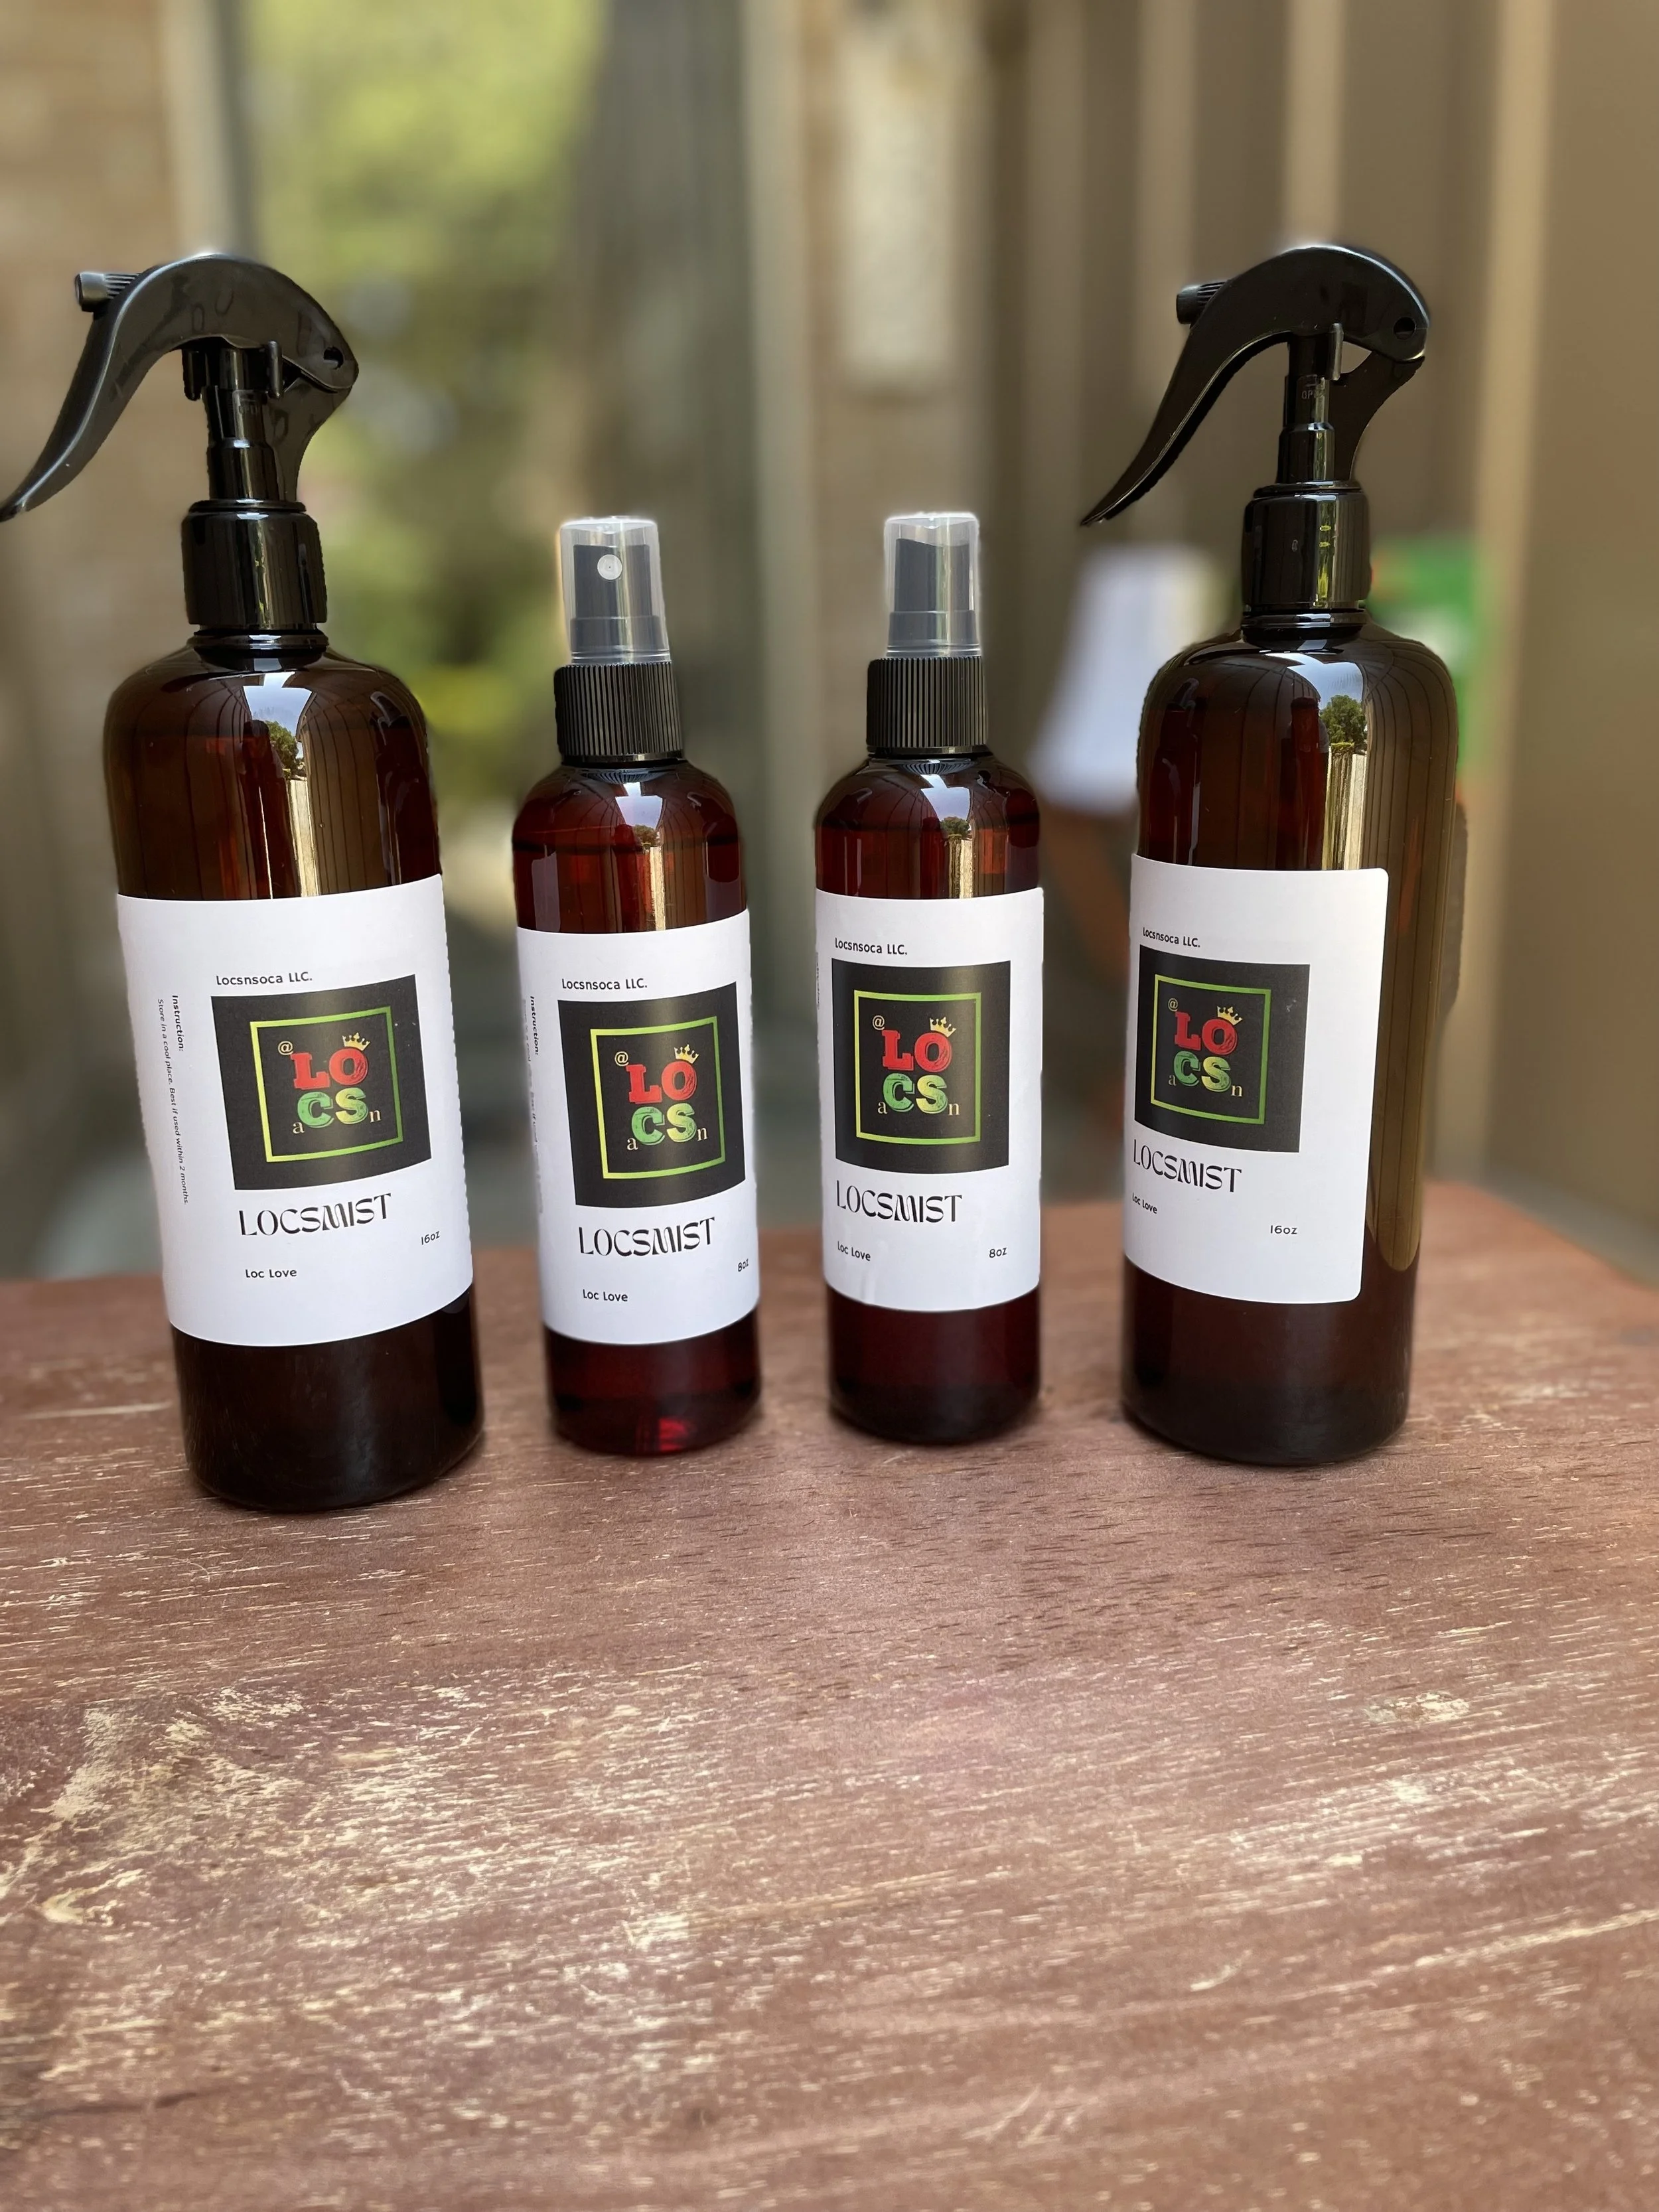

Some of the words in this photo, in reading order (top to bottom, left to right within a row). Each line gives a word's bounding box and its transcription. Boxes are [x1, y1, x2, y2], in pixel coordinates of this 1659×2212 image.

[835, 936, 883, 954] Locsnsoca
[887, 943, 908, 956] LLC.
[1183, 936, 1200, 948] LLC.
[216, 975, 283, 986] Locsnsoca
[288, 971, 313, 983] LLC.
[561, 978, 620, 990] Locsnsoca
[625, 978, 648, 990] LLC.
[172, 995, 184, 1052] Instruction:
[530, 995, 539, 1055] Instruction:
[1133, 1139, 1242, 1193] LOCSMIST
[836, 1179, 963, 1223] LOCSMIST
[1132, 1193, 1141, 1206] Loc
[1142, 1199, 1158, 1215] Love
[238, 1193, 392, 1236] LOCSMIST
[421, 1230, 440, 1246] 16oz
[578, 1217, 715, 1257] LOCSMIST
[1270, 1224, 1297, 1235] 16oz
[837, 1240, 849, 1254] Loc
[851, 1246, 871, 1262] Love
[989, 1247, 1007, 1258] 8oz
[245, 1269, 265, 1278] Loc
[269, 1269, 297, 1278] Love
[737, 1258, 749, 1272] 8oz
[583, 1288, 599, 1300] Loc
[603, 1291, 628, 1302] Love
